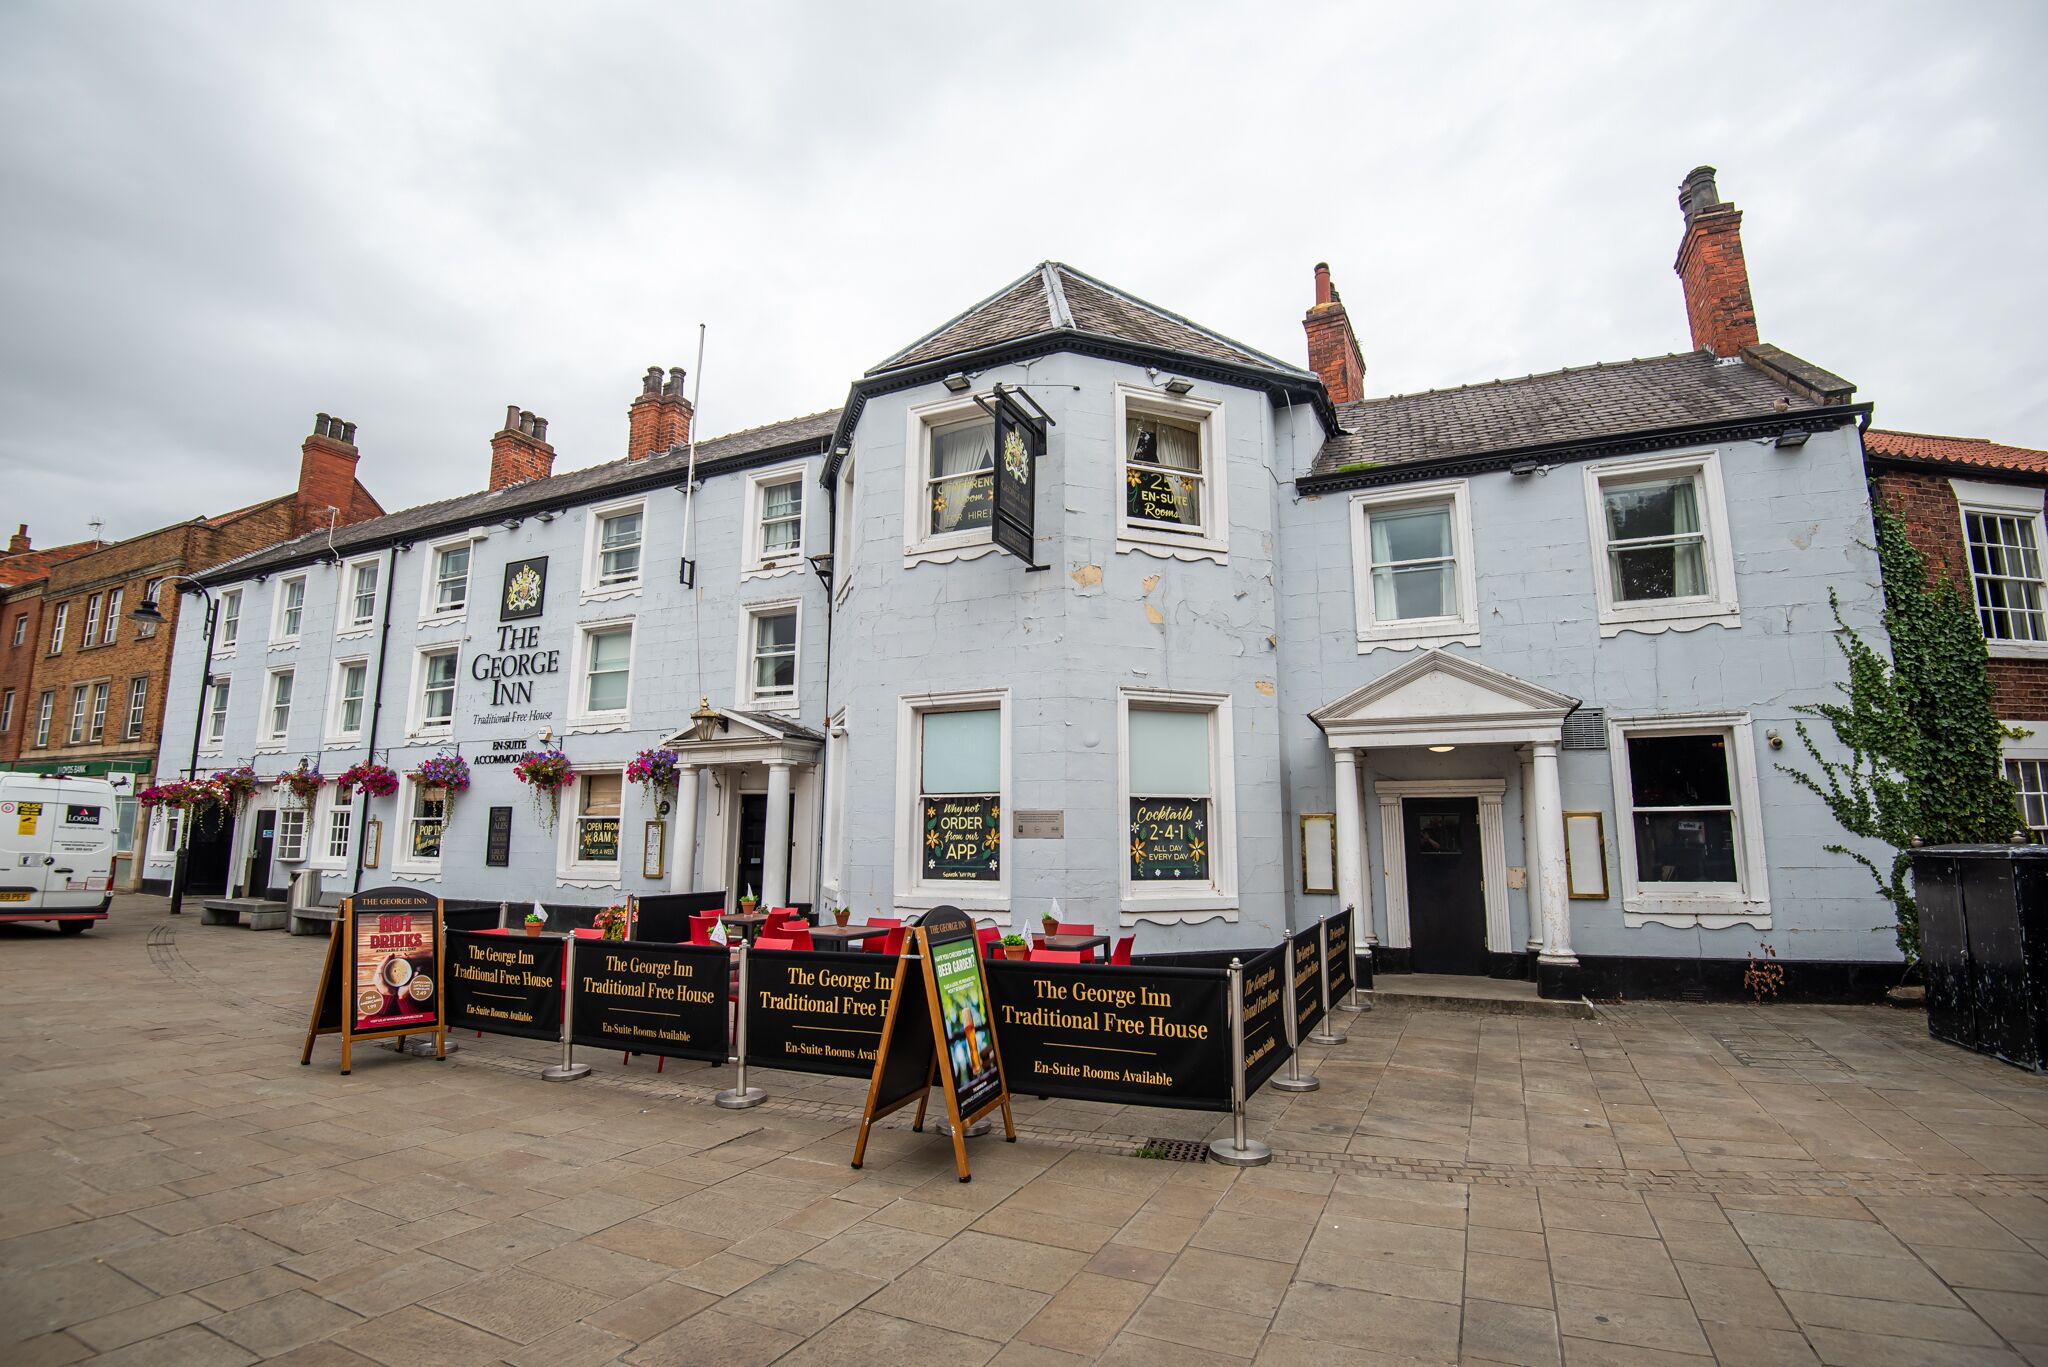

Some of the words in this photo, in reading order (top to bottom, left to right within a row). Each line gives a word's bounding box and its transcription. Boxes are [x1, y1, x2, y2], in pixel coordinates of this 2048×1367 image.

[1151, 473, 1173, 492] 25
[1141, 491, 1188, 506] EN-SUITE
[968, 509, 992, 520] HIRE!
[1144, 502, 1180, 519] Rooms
[497, 625, 540, 651] THE
[472, 650, 559, 680] GEORGE
[490, 679, 533, 705] INN
[473, 712, 510, 724] Traditional
[512, 711, 527, 722] Free
[529, 710, 552, 721] House
[474, 755, 525, 764] ACCOMMODA
[68, 814, 98, 822] LOOMIS
[944, 804, 962, 816] Why
[964, 803, 980, 812] not
[1137, 806, 1193, 823] Cocktails
[420, 825, 433, 836] POP
[494, 822, 508, 830] ALES
[586, 822, 602, 830] OPEN
[604, 822, 620, 830] FROM
[941, 817, 982, 829] ORDER
[594, 832, 611, 842] 8AM
[944, 830, 963, 842] from
[965, 832, 979, 840] our
[1150, 824, 1184, 840] 2-4-1
[946, 844, 976, 860] APP
[379, 916, 413, 933] HOT
[930, 925, 940, 934] THE
[940, 921, 958, 933] GEORGE
[958, 920, 966, 928] INN
[370, 933, 422, 948] DRINKS
[468, 945, 485, 960] The
[486, 947, 516, 966] George
[518, 950, 534, 964] Inn
[606, 956, 627, 972] The
[630, 957, 671, 978] George
[673, 960, 693, 977] Inn
[938, 962, 952, 977] BEER
[952, 954, 975, 973] GARDEN?
[454, 963, 498, 983] Traditional
[500, 970, 520, 985] Free
[522, 972, 552, 987] House
[788, 968, 815, 986] The
[819, 969, 870, 992] George
[1245, 979, 1254, 997] The
[1254, 974, 1268, 991] George
[1268, 966, 1276, 982] Inn
[584, 977, 645, 998] Traditional
[648, 982, 674, 1000] Free
[677, 985, 714, 1003] House
[1034, 980, 1067, 999] The
[1072, 982, 1135, 1008] George
[1140, 986, 1171, 1007] Inn
[760, 991, 839, 1014] Traditional
[842, 997, 876, 1016] Free
[1258, 996, 1267, 1013] Free
[1267, 989, 1279, 1007] House
[466, 1004, 490, 1016] En-Suite
[490, 1008, 508, 1019] Rooms
[509, 1011, 533, 1022] Available
[1002, 1005, 1099, 1031] Traditional
[1104, 1012, 1144, 1035] Free
[1150, 1016, 1208, 1040] House
[602, 1022, 632, 1034] En-Suite
[633, 1026, 657, 1038] Rooms
[658, 1029, 691, 1042] Available
[785, 1042, 823, 1055] En-Suite
[825, 1045, 855, 1058] Rooms
[857, 1048, 879, 1060] Avail
[1034, 1061, 1080, 1077] En-Suite
[1083, 1065, 1120, 1081] Rooms
[1122, 1069, 1173, 1086] Available
